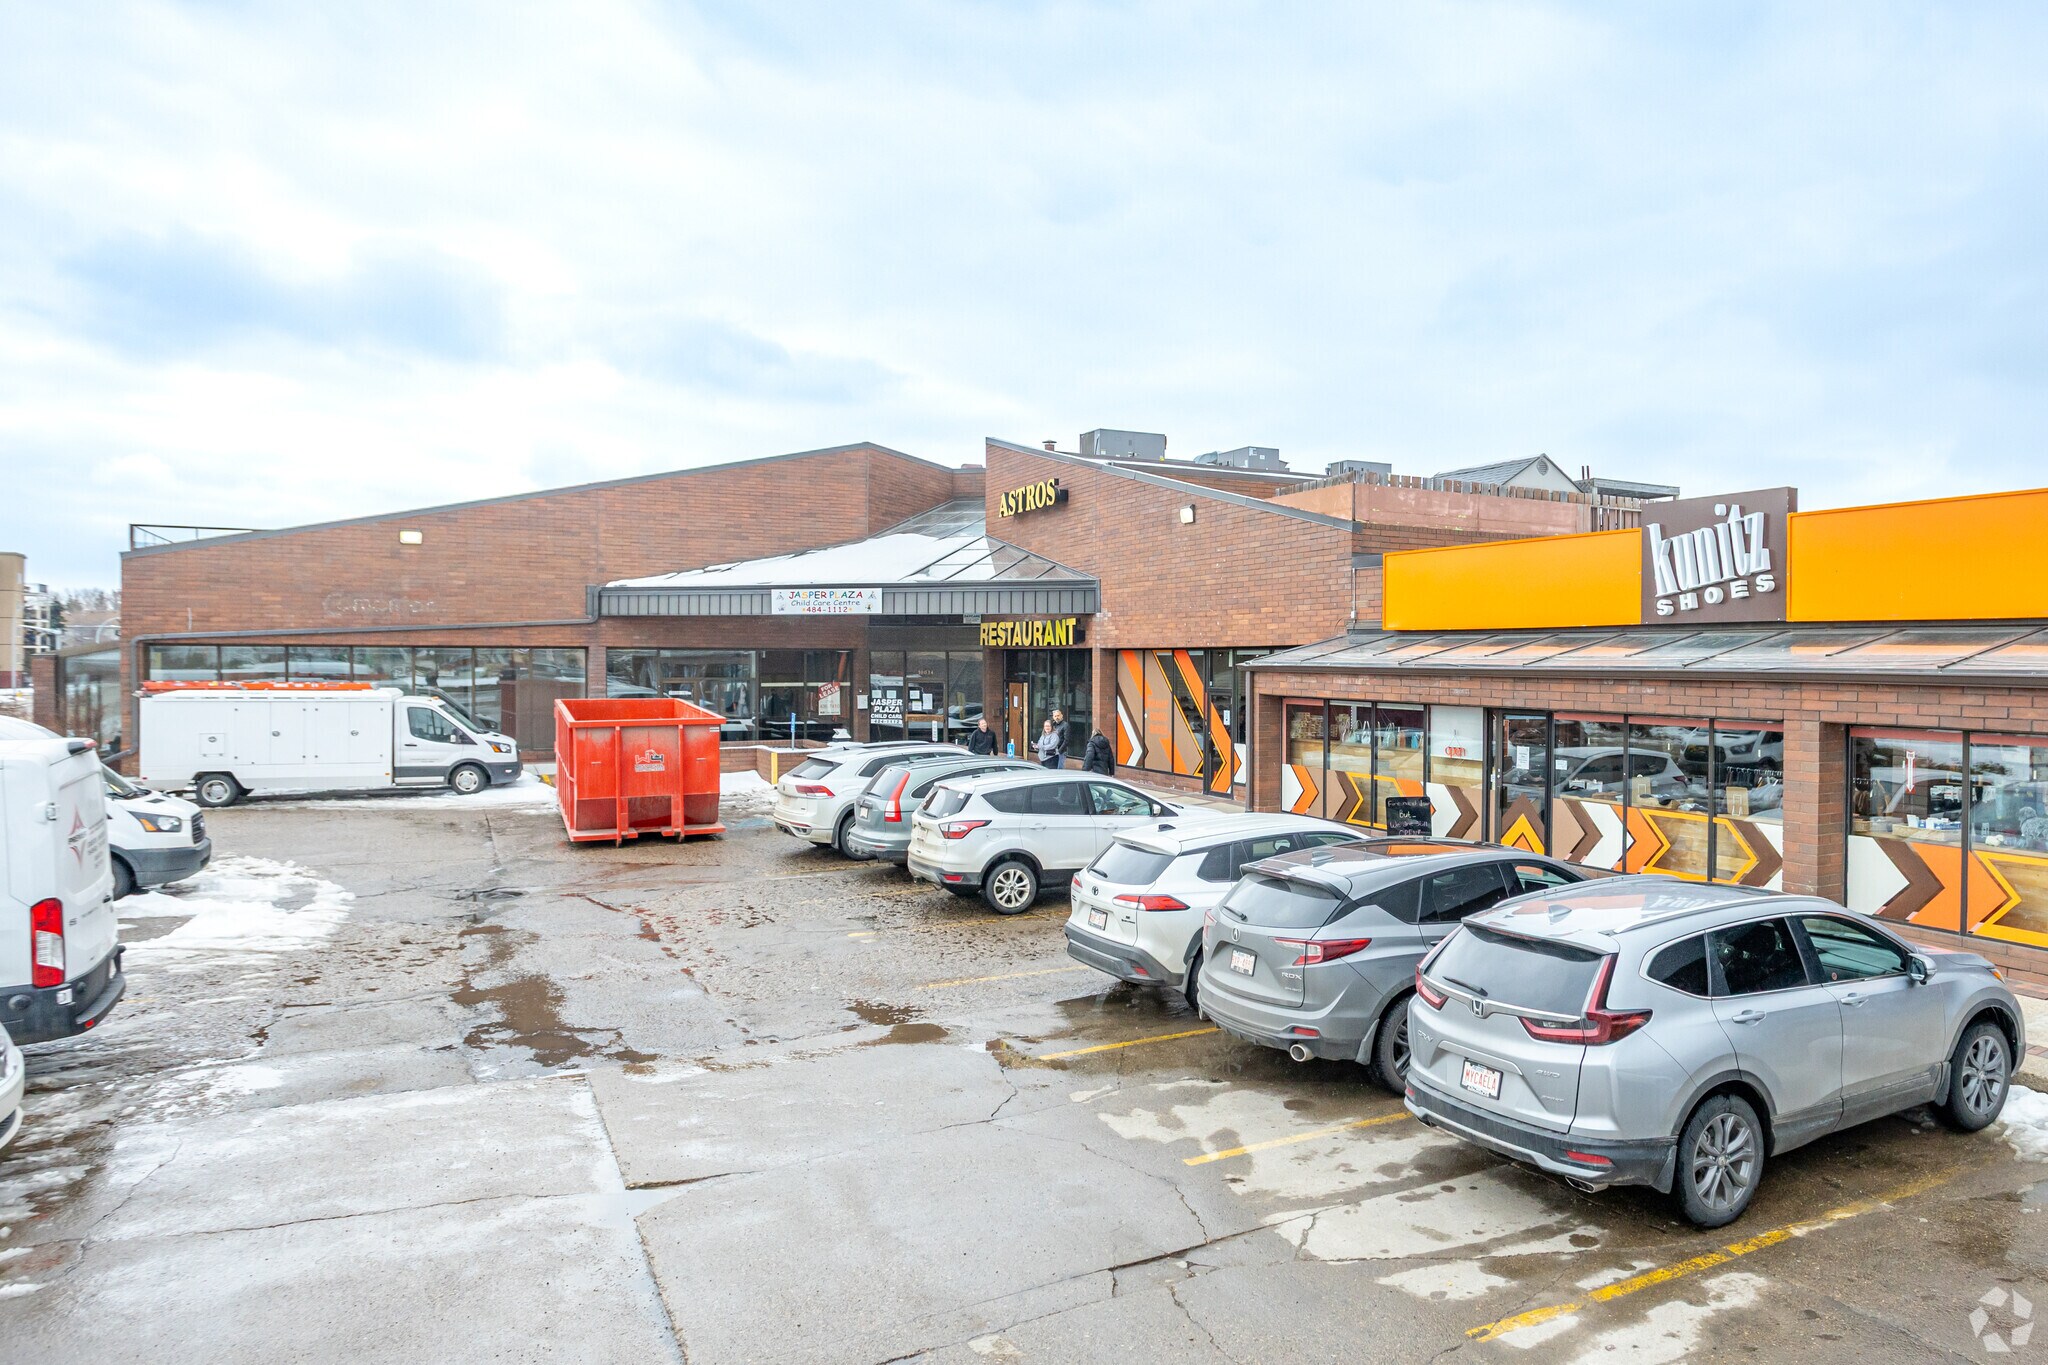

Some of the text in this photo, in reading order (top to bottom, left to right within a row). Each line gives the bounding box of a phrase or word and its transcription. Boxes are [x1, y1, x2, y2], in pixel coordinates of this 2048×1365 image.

[998, 478, 1056, 518] ASTROS
[788, 591, 863, 600] JASPER PLAZA
[1656, 574, 1776, 616] SHOES
[790, 599, 861, 607] Child Care Centre
[980, 617, 1077, 647] RESTAURANT
[818, 685, 840, 699] LEASE
[820, 683, 833, 692] FOR
[870, 698, 903, 706] JASPER
[1281, 971, 1303, 980] RDX
[1535, 1069, 1561, 1079] AWD
[1464, 1068, 1497, 1092] MYCAELA
